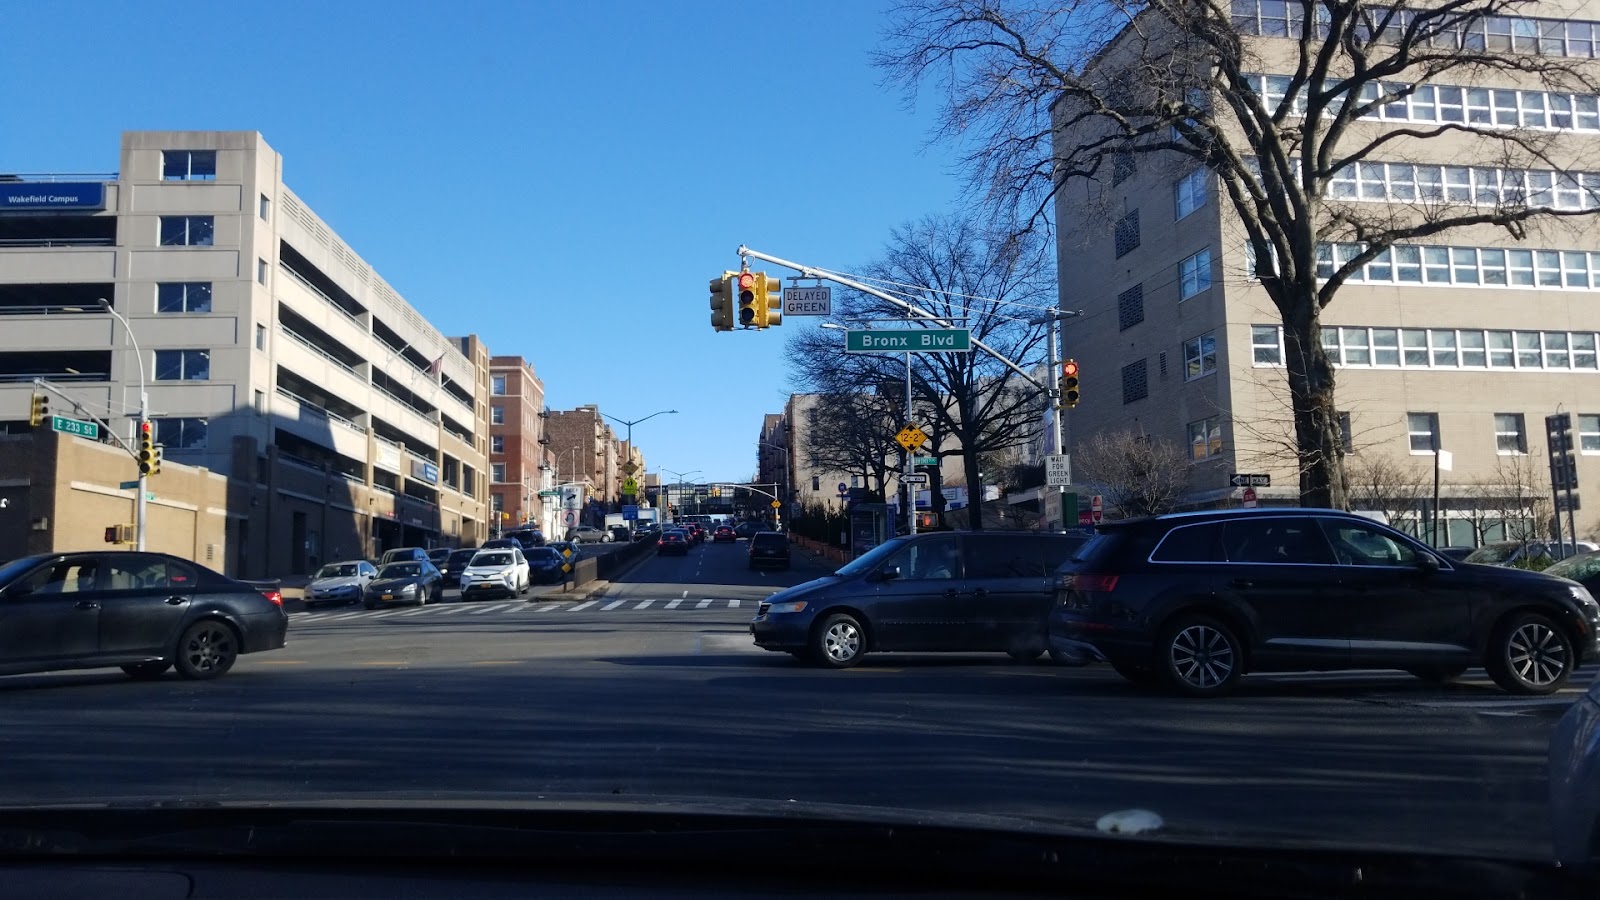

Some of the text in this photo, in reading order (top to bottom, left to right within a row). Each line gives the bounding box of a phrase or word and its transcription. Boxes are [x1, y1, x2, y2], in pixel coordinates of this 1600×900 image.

[8, 195, 79, 204] Wakefield Campus
[787, 291, 828, 301] DELAYED
[788, 302, 827, 312] GREEN
[862, 334, 955, 347] Bronx Blvd
[58, 419, 92, 434] E 233 St
